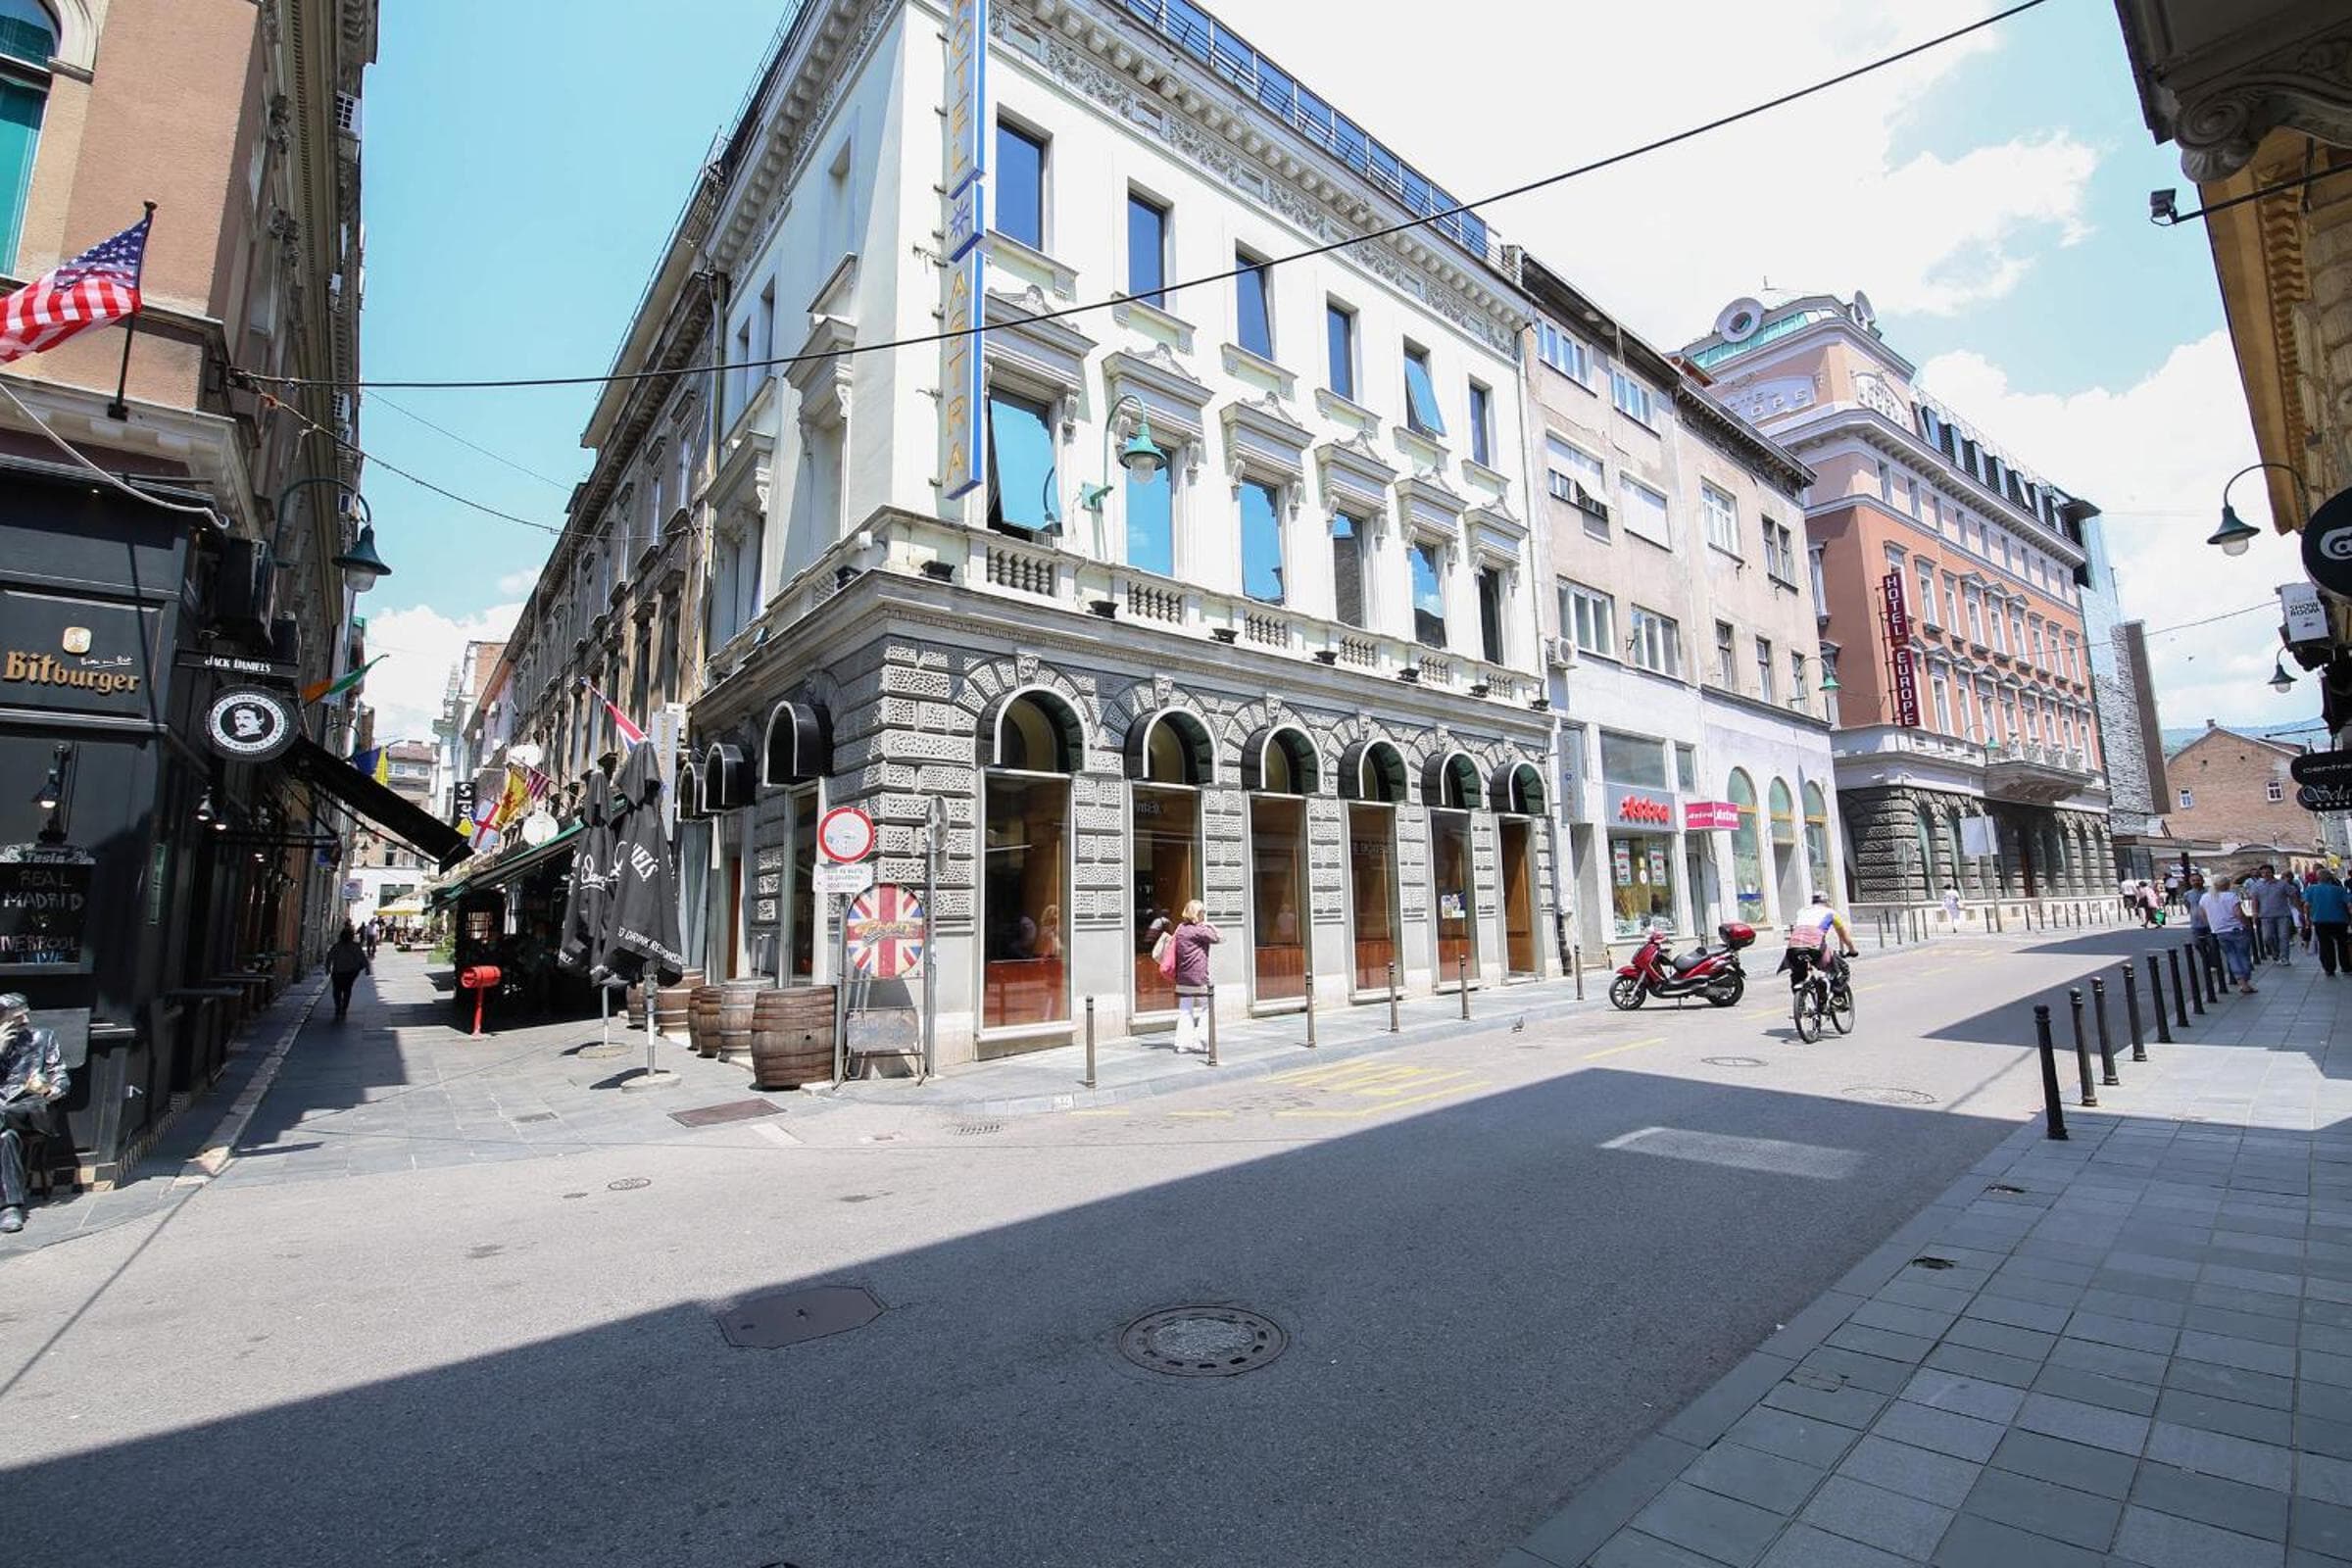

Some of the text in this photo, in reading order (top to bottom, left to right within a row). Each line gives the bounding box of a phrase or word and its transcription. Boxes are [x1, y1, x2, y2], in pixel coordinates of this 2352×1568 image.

[947, 270, 969, 482] ASTRA
[3, 650, 140, 694] Bitburger
[204, 655, 272, 673] JACK DANIELS
[1886, 576, 1914, 725] HOTEL EUROPE
[4, 890, 85, 911] MADRID
